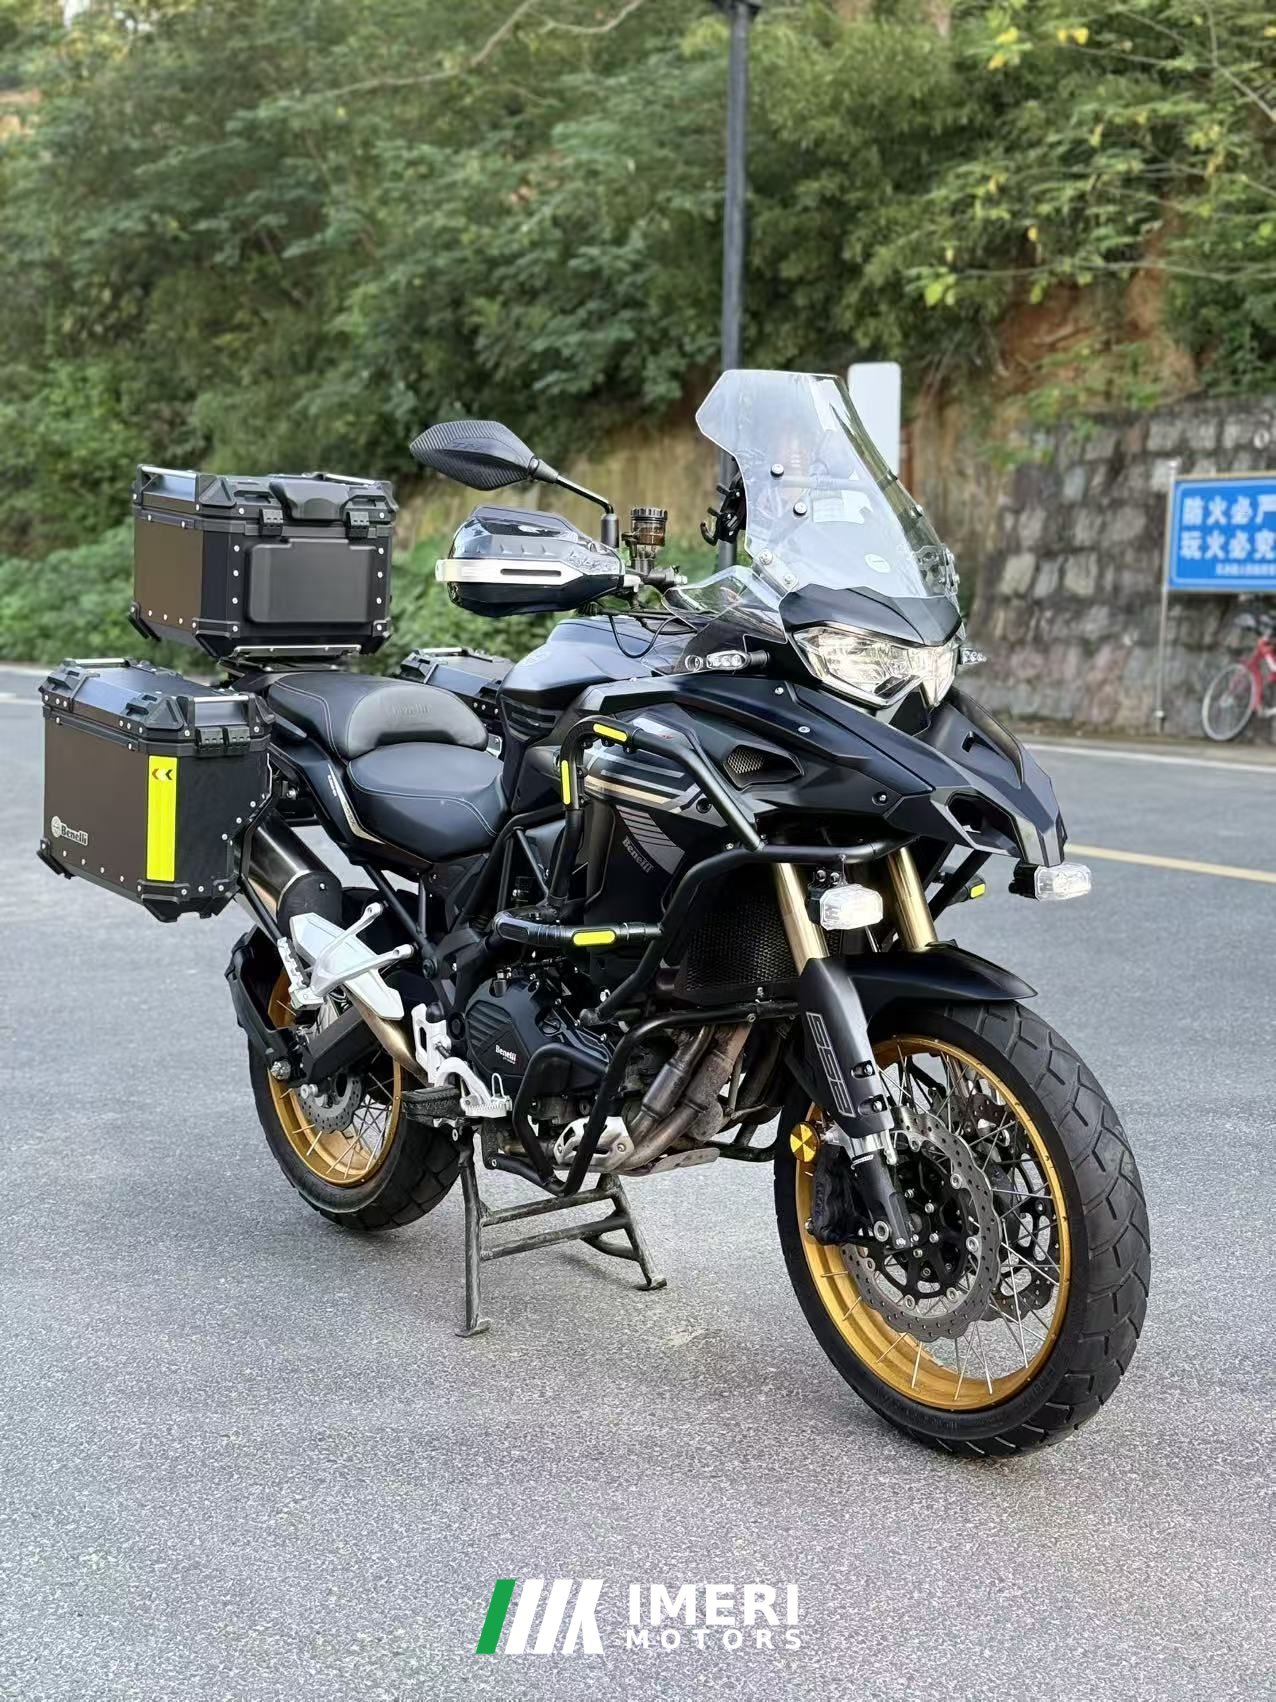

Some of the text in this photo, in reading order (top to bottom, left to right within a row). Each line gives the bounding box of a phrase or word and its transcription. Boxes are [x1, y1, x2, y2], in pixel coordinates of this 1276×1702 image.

[61, 823, 88, 845] Benelli
[622, 834, 654, 873] Benelli
[495, 1044, 517, 1062] Benelli
